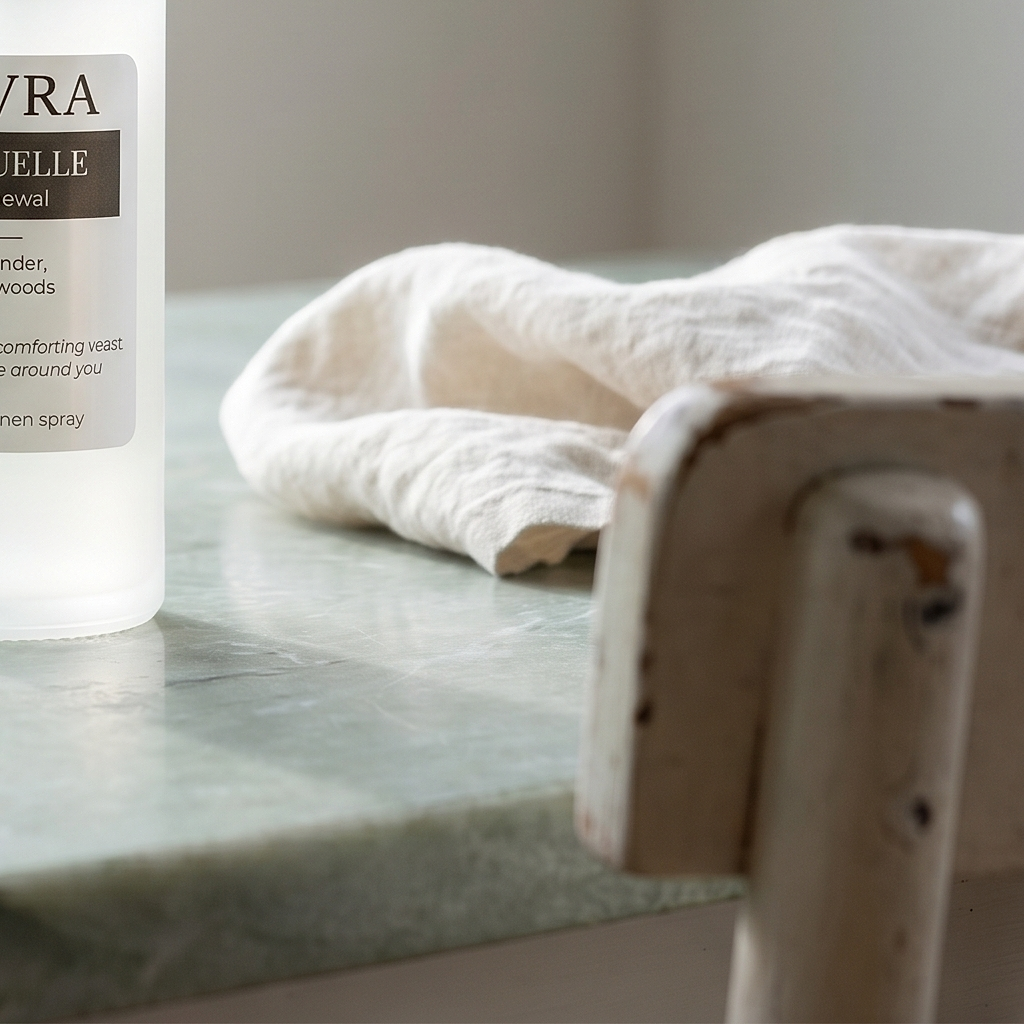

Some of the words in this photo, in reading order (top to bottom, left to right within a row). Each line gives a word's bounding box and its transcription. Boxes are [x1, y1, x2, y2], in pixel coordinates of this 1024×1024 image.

[88, 337, 123, 352] veast
[10, 362, 72, 377] around
[74, 362, 102, 379] you
[39, 414, 85, 429] spray
